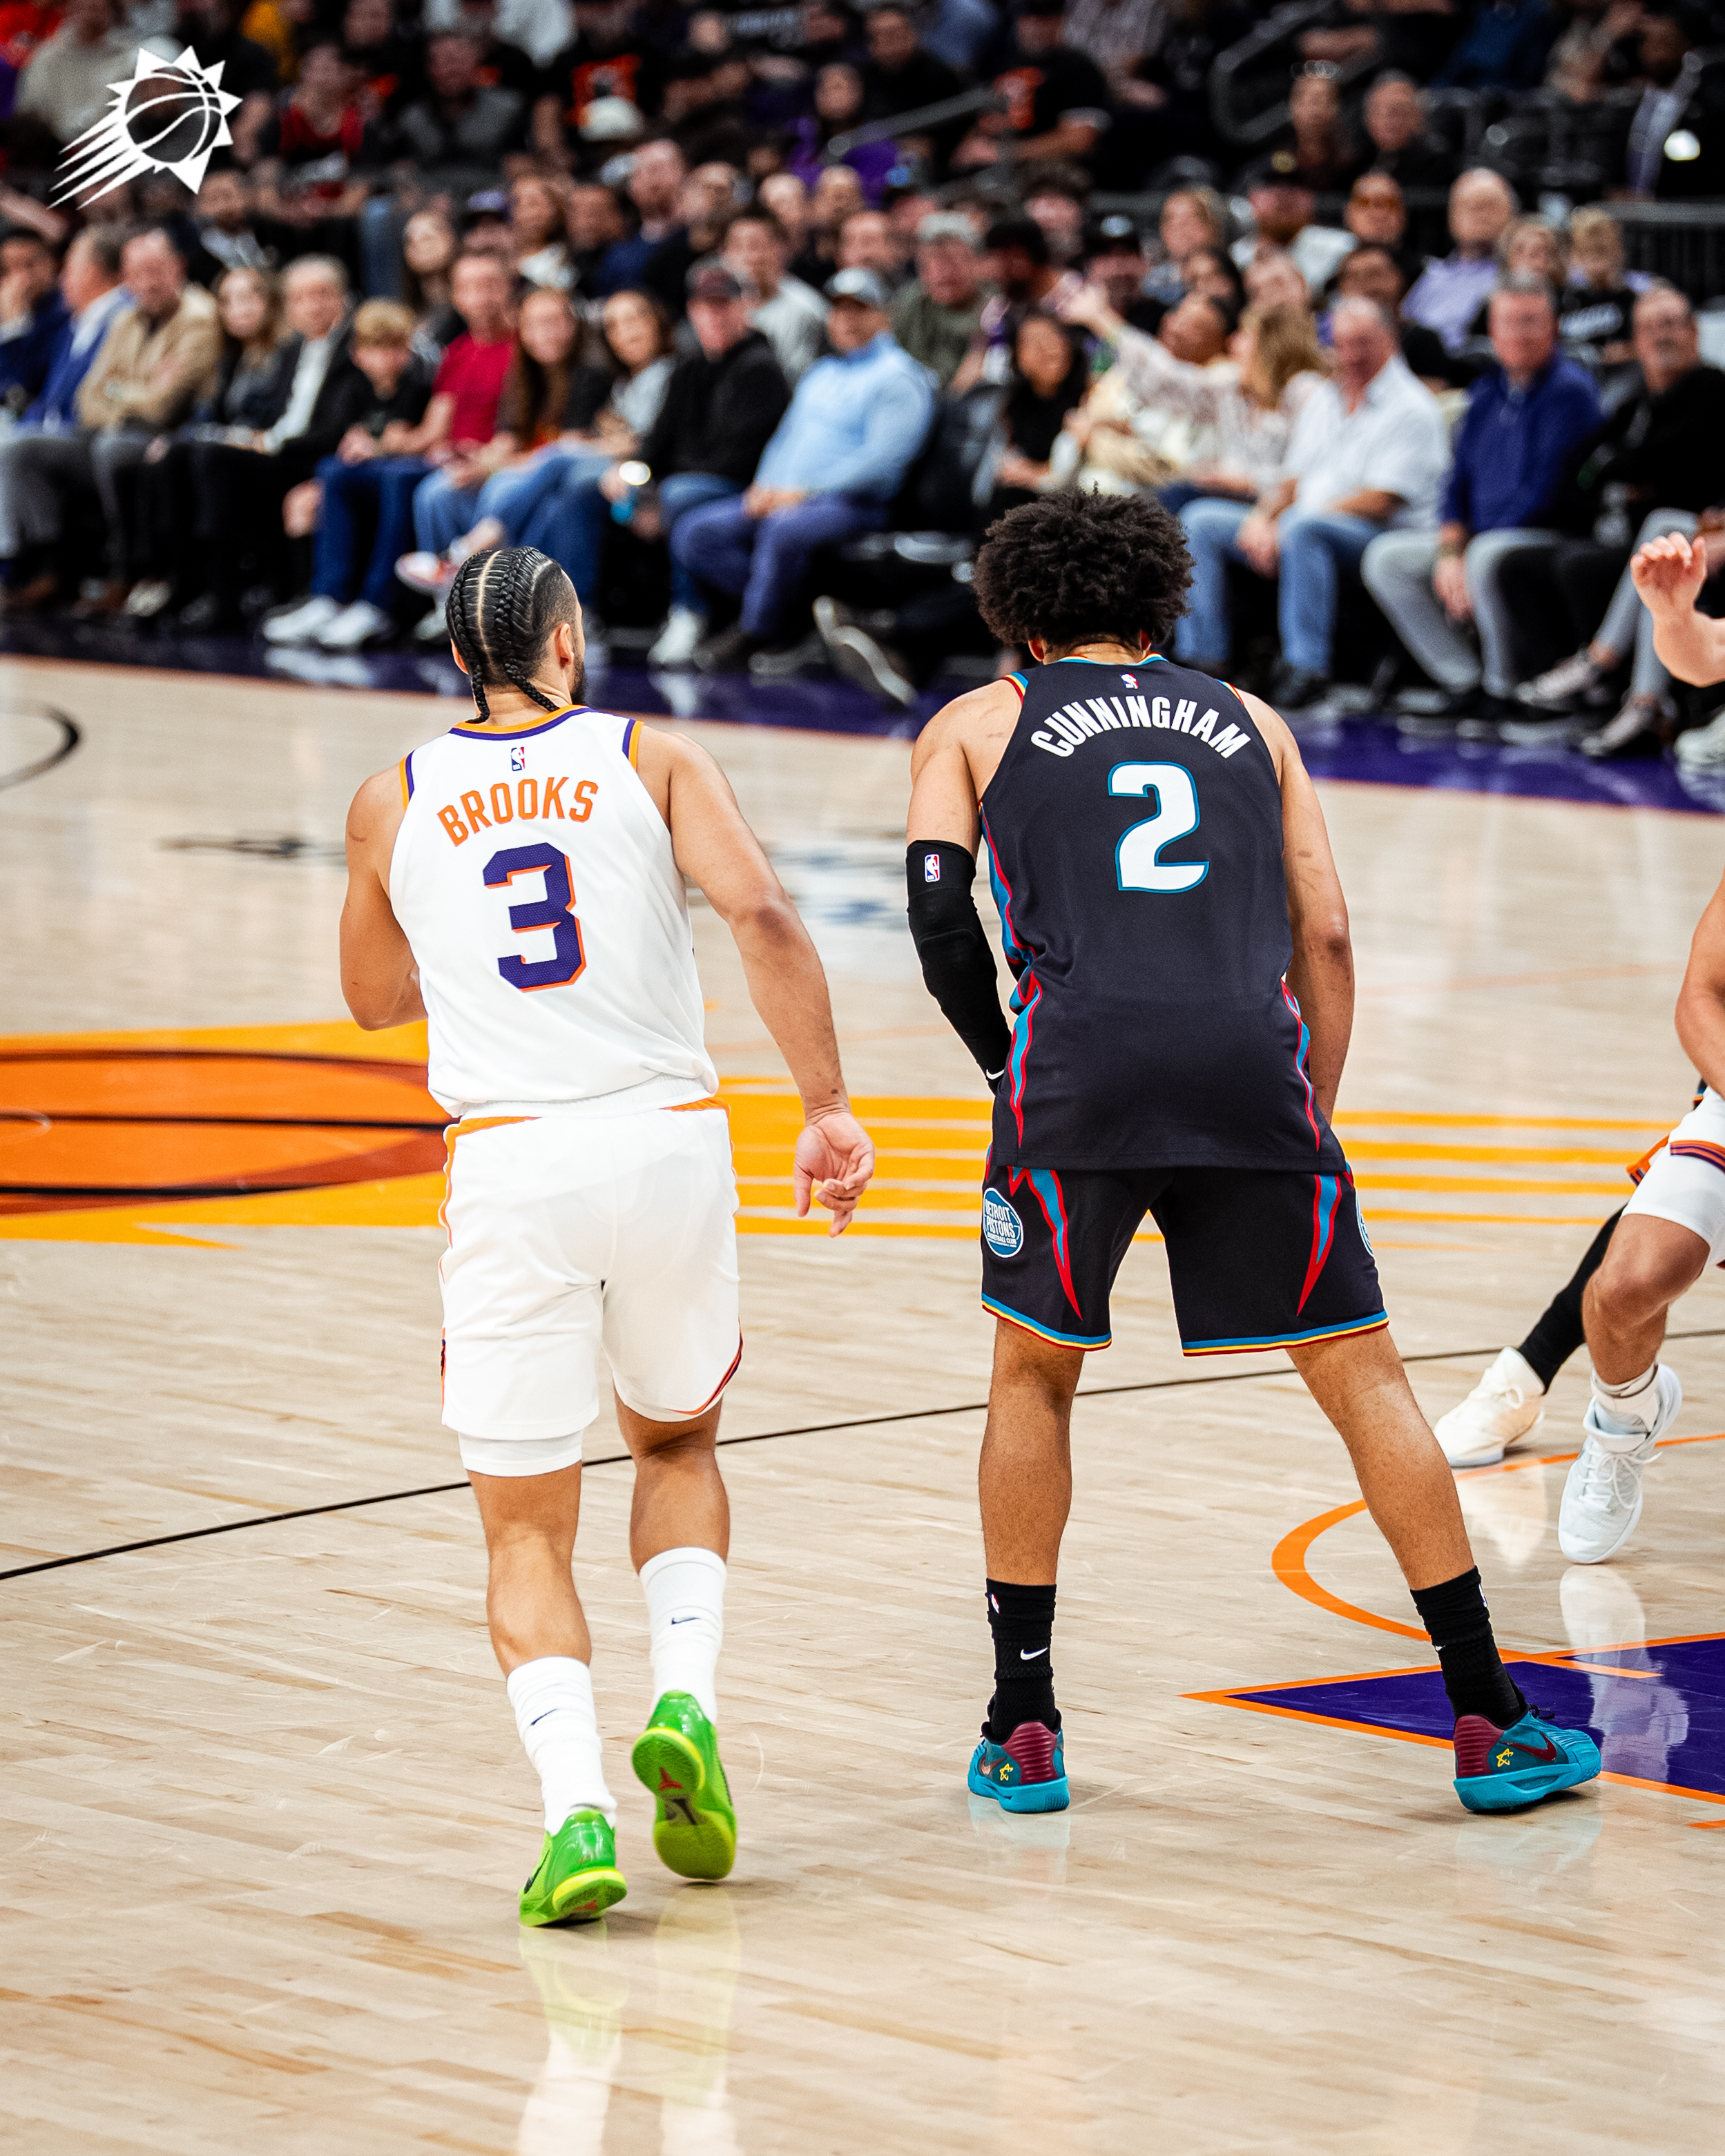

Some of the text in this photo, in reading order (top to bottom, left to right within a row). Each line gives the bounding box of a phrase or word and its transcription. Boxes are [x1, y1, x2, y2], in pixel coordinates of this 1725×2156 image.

[1031, 695, 1251, 759] CUNNINGHAM
[437, 777, 599, 847] BROOKS
[1107, 760, 1209, 893] 2
[483, 842, 587, 993] 3
[985, 1198, 1011, 1222] DETROIT
[987, 1216, 1016, 1239] PISTONS
